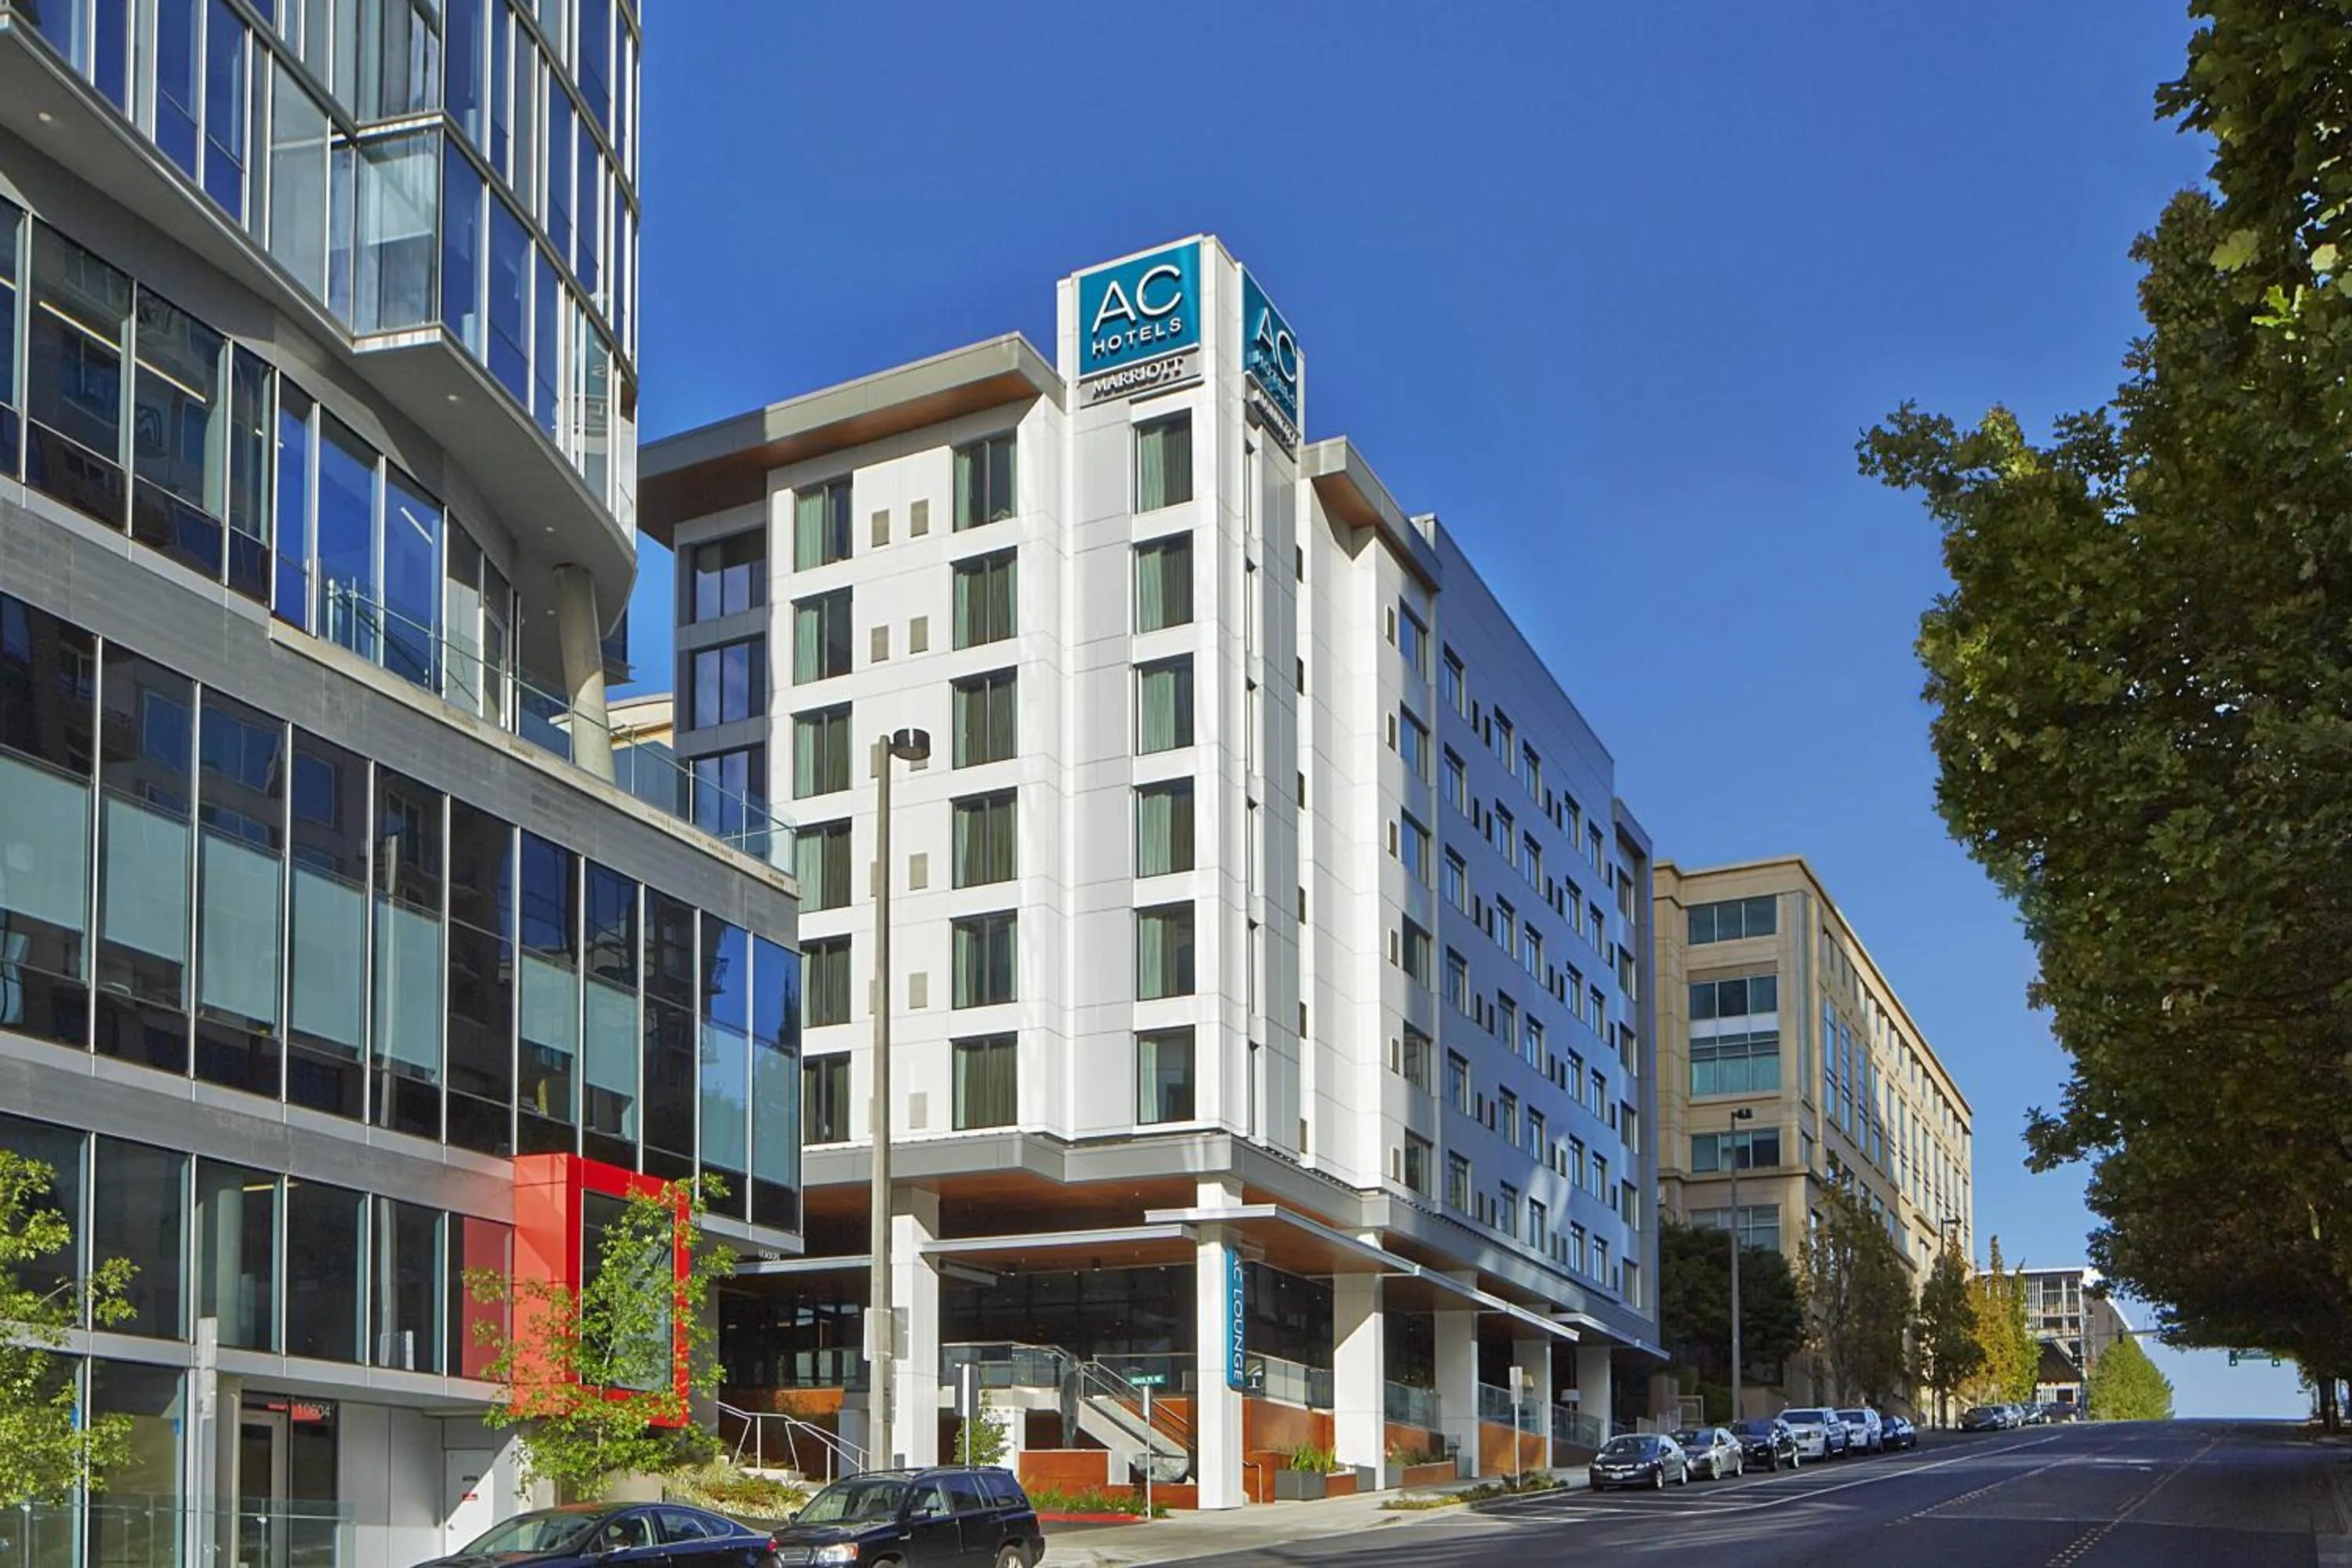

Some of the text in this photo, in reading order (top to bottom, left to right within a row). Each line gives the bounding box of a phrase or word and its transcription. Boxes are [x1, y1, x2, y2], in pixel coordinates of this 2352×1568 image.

[1092, 264, 1182, 333] AC
[1092, 318, 1182, 355] HOTELS
[1258, 307, 1296, 383] AC
[1093, 357, 1185, 391] MARRIOTT
[1233, 1288, 1243, 1381] LOUNGE
